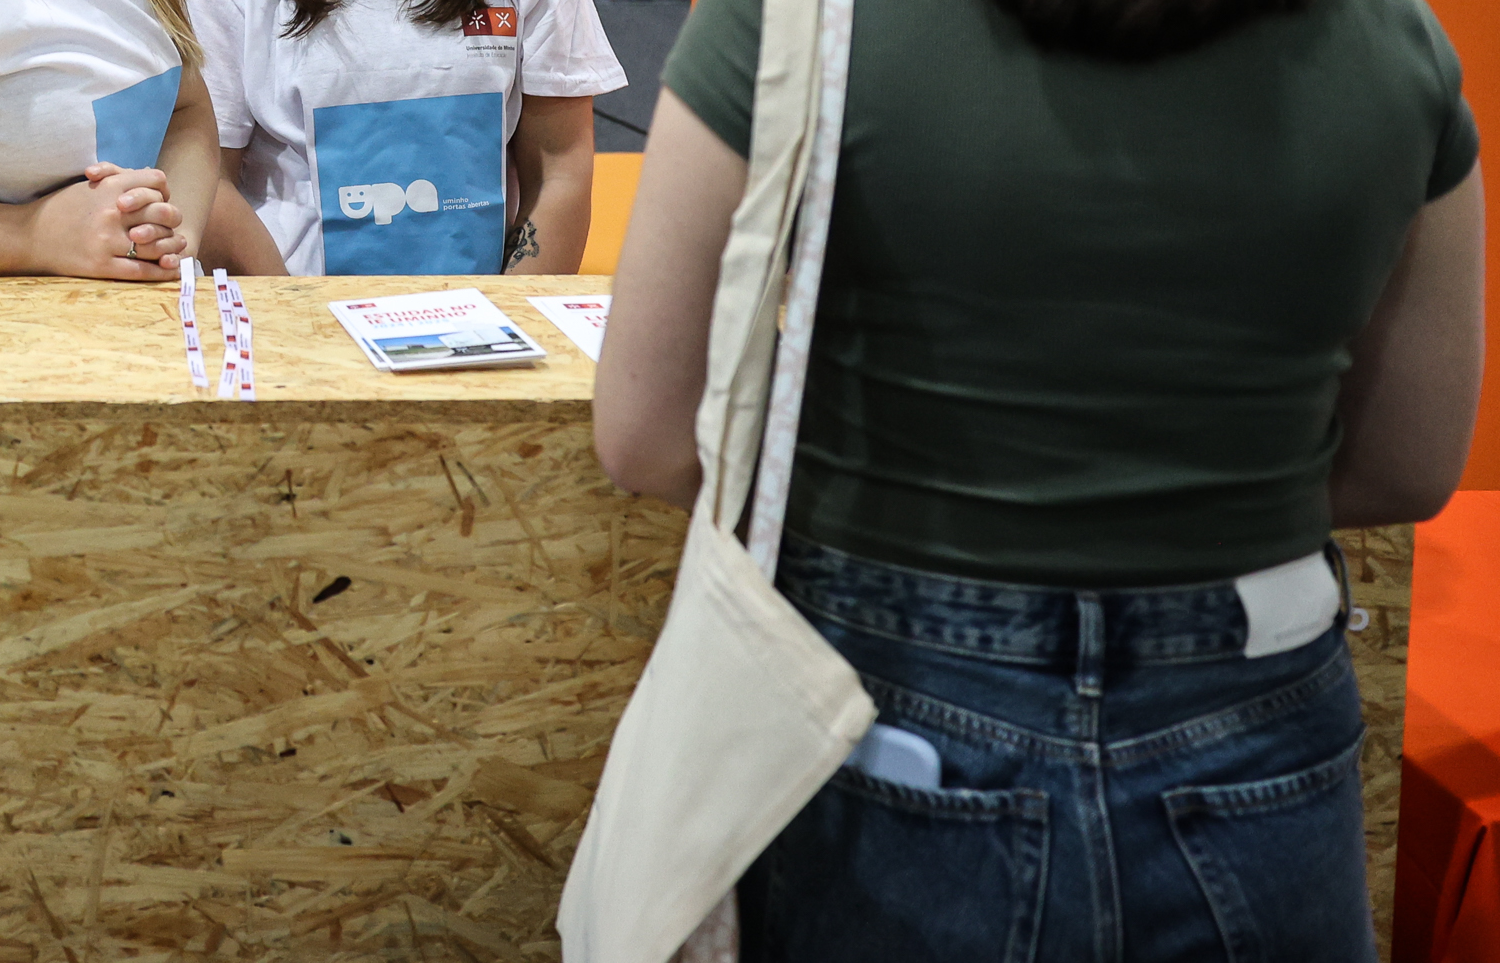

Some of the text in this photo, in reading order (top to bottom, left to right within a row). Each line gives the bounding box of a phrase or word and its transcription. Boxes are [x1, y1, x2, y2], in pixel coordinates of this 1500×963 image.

[338, 179, 439, 226] upa
[442, 197, 469, 205] uminho
[467, 200, 490, 209] abertas
[363, 307, 445, 319] ESTUDAR
[450, 303, 476, 311] NO
[389, 311, 467, 323] UMINHO
